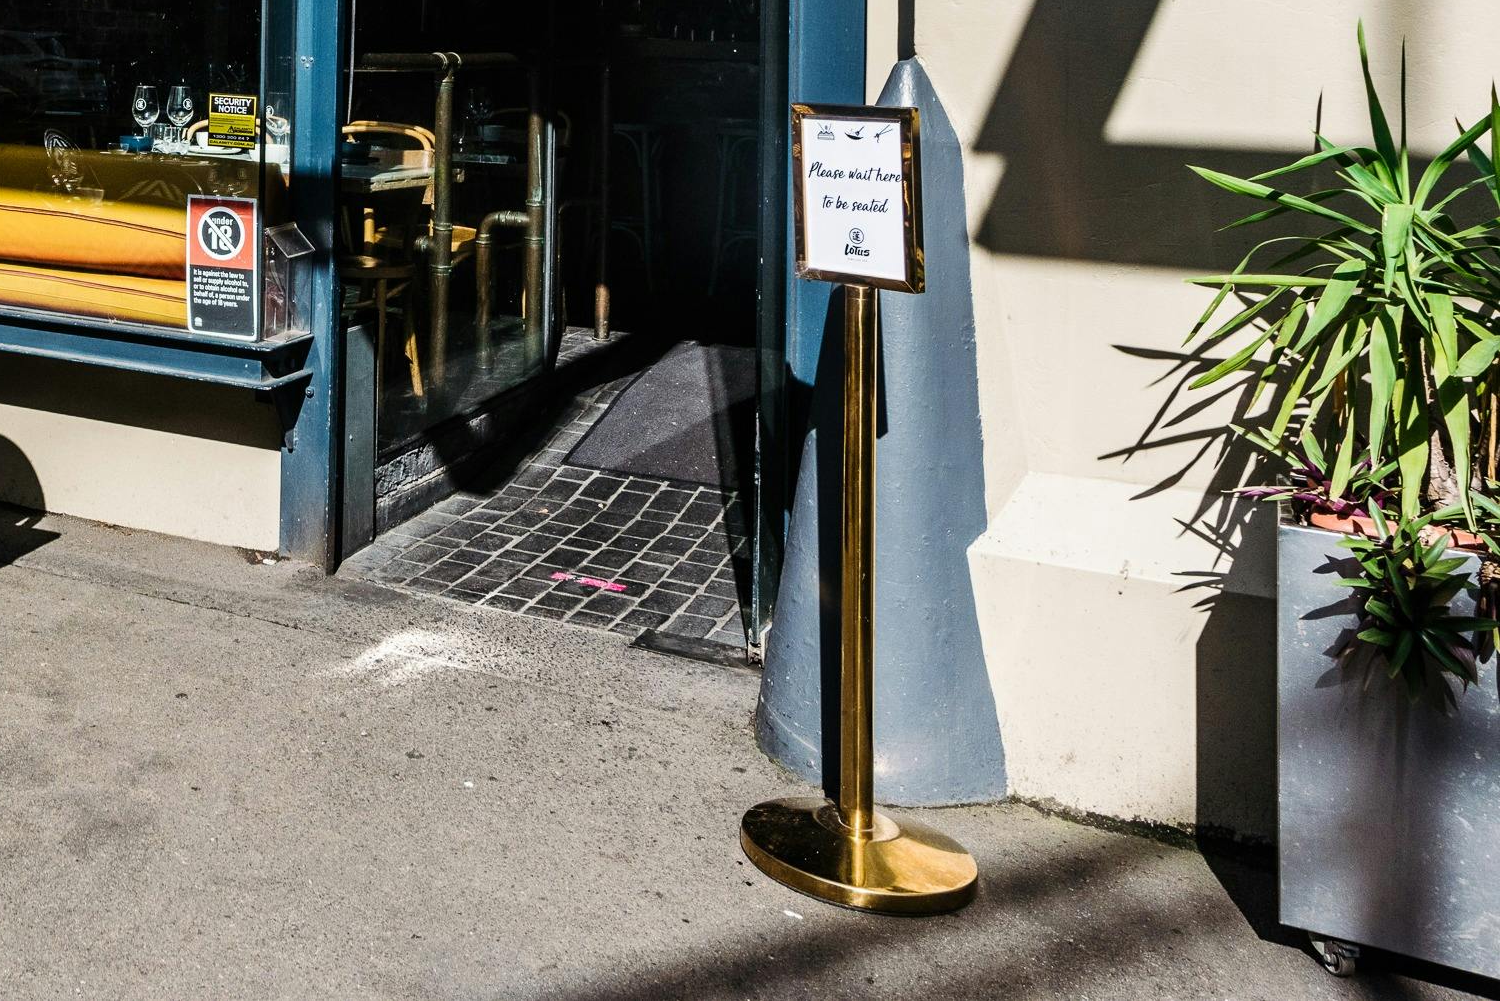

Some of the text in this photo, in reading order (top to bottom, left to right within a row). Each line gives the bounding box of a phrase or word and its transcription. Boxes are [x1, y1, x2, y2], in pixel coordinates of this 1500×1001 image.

[214, 96, 251, 107] SECURITY
[218, 104, 247, 115] NOTICE
[808, 161, 902, 182] Please wait here
[822, 195, 888, 213] to be seated
[211, 216, 233, 226] under
[208, 226, 233, 250] 18
